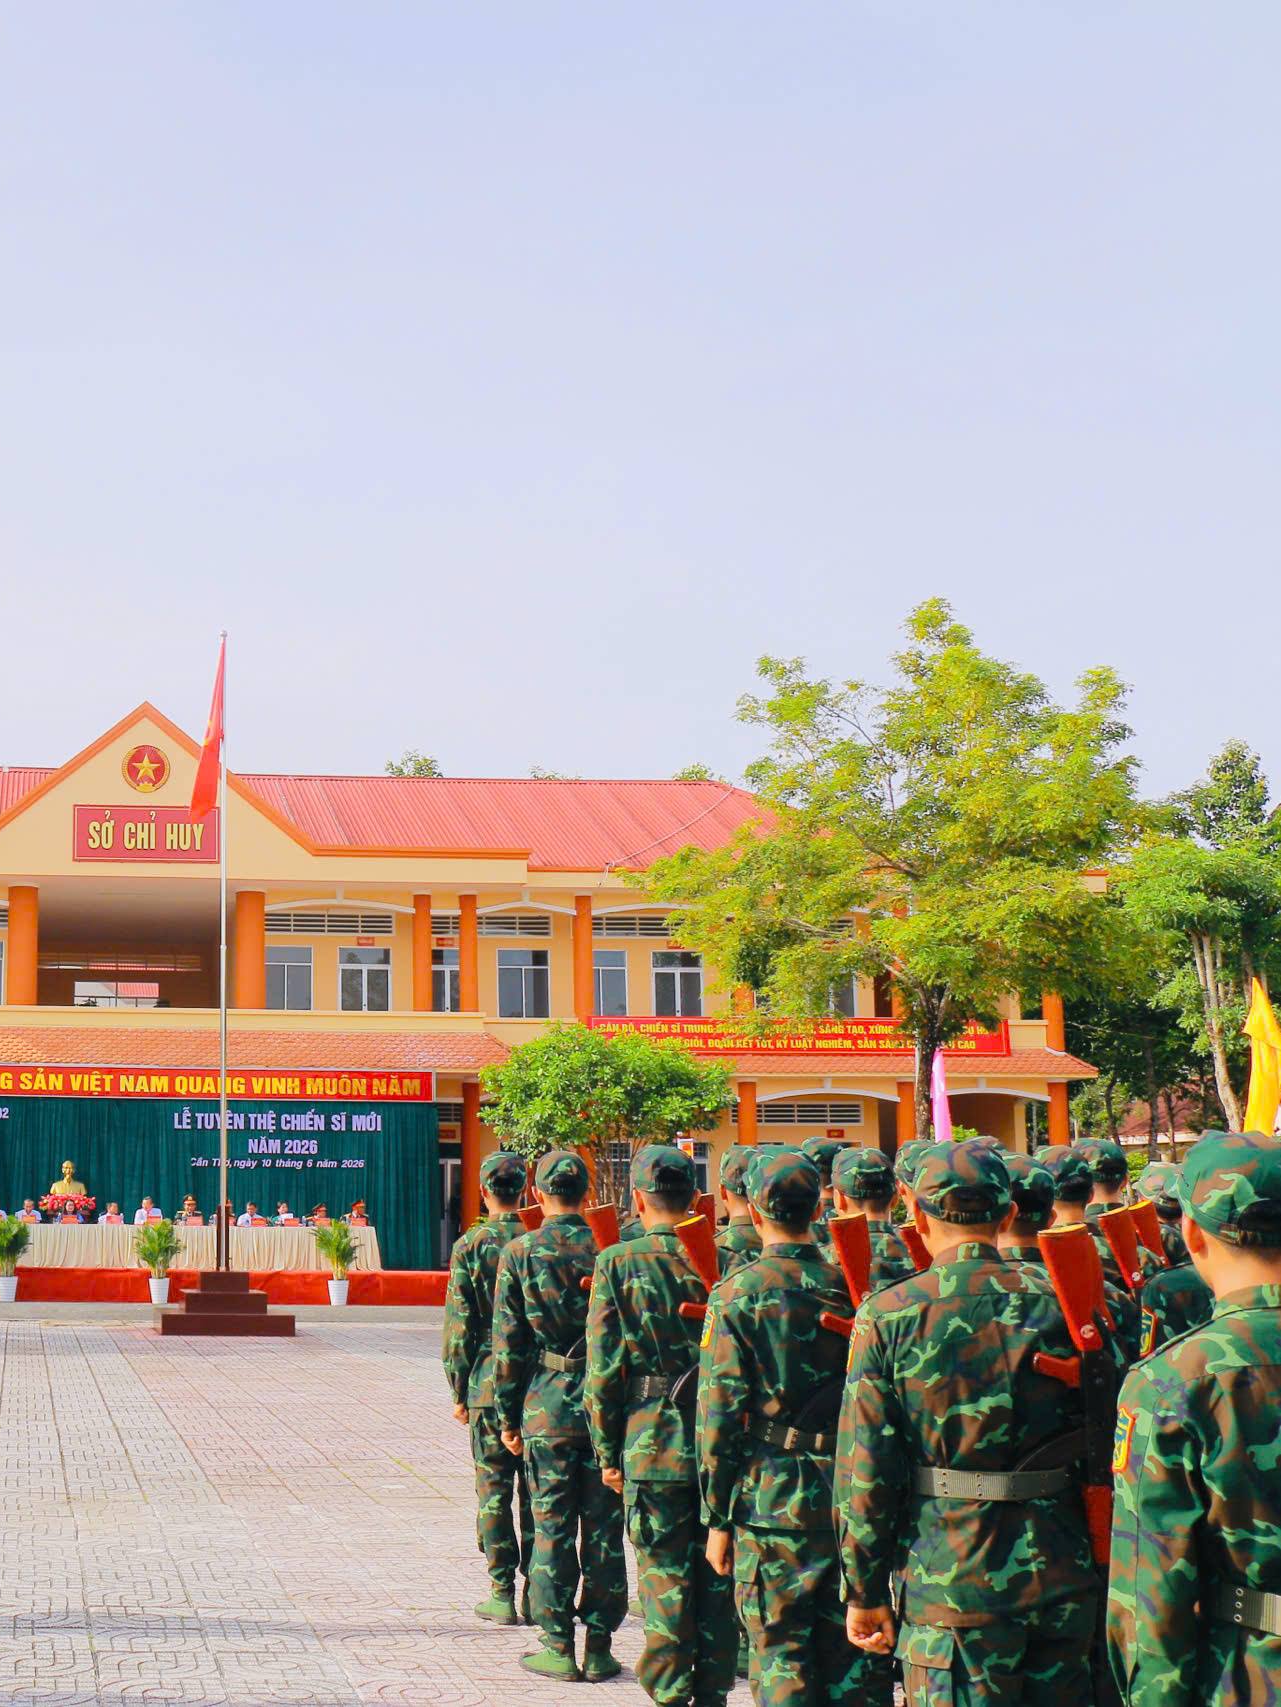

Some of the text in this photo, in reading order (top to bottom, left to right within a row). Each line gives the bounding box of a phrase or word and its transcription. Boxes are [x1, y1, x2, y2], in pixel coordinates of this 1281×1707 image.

[88, 810, 205, 850] SỞ CHỈ HUY
[640, 1020, 668, 1033] CHIẾN
[671, 1022, 680, 1033] SĨ
[683, 1023, 713, 1033] TRUNG
[846, 1024, 867, 1036] TẠO,
[791, 1037, 813, 1050] LUẬT
[815, 1037, 855, 1050] NGHIÊM,
[958, 1040, 976, 1049] CAO
[20, 1067, 63, 1091] SẢN
[70, 1070, 114, 1095] VIỆT
[120, 1074, 169, 1093] NAM
[175, 1075, 246, 1095] QUANG
[251, 1076, 300, 1095] VINH
[305, 1074, 367, 1096] MUÔN
[371, 1074, 422, 1097] NĂM
[174, 1107, 382, 1133] LỄ TUYÊN THỆ CHIẾN SĨ MỚI
[248, 1136, 319, 1155] NĂM 2026
[234, 1158, 257, 1169] ngày
[262, 1159, 272, 1167] 10
[276, 1157, 303, 1170] tháng
[306, 1159, 313, 1168] 6
[316, 1157, 338, 1168] năm
[341, 1159, 365, 1168] 2026
